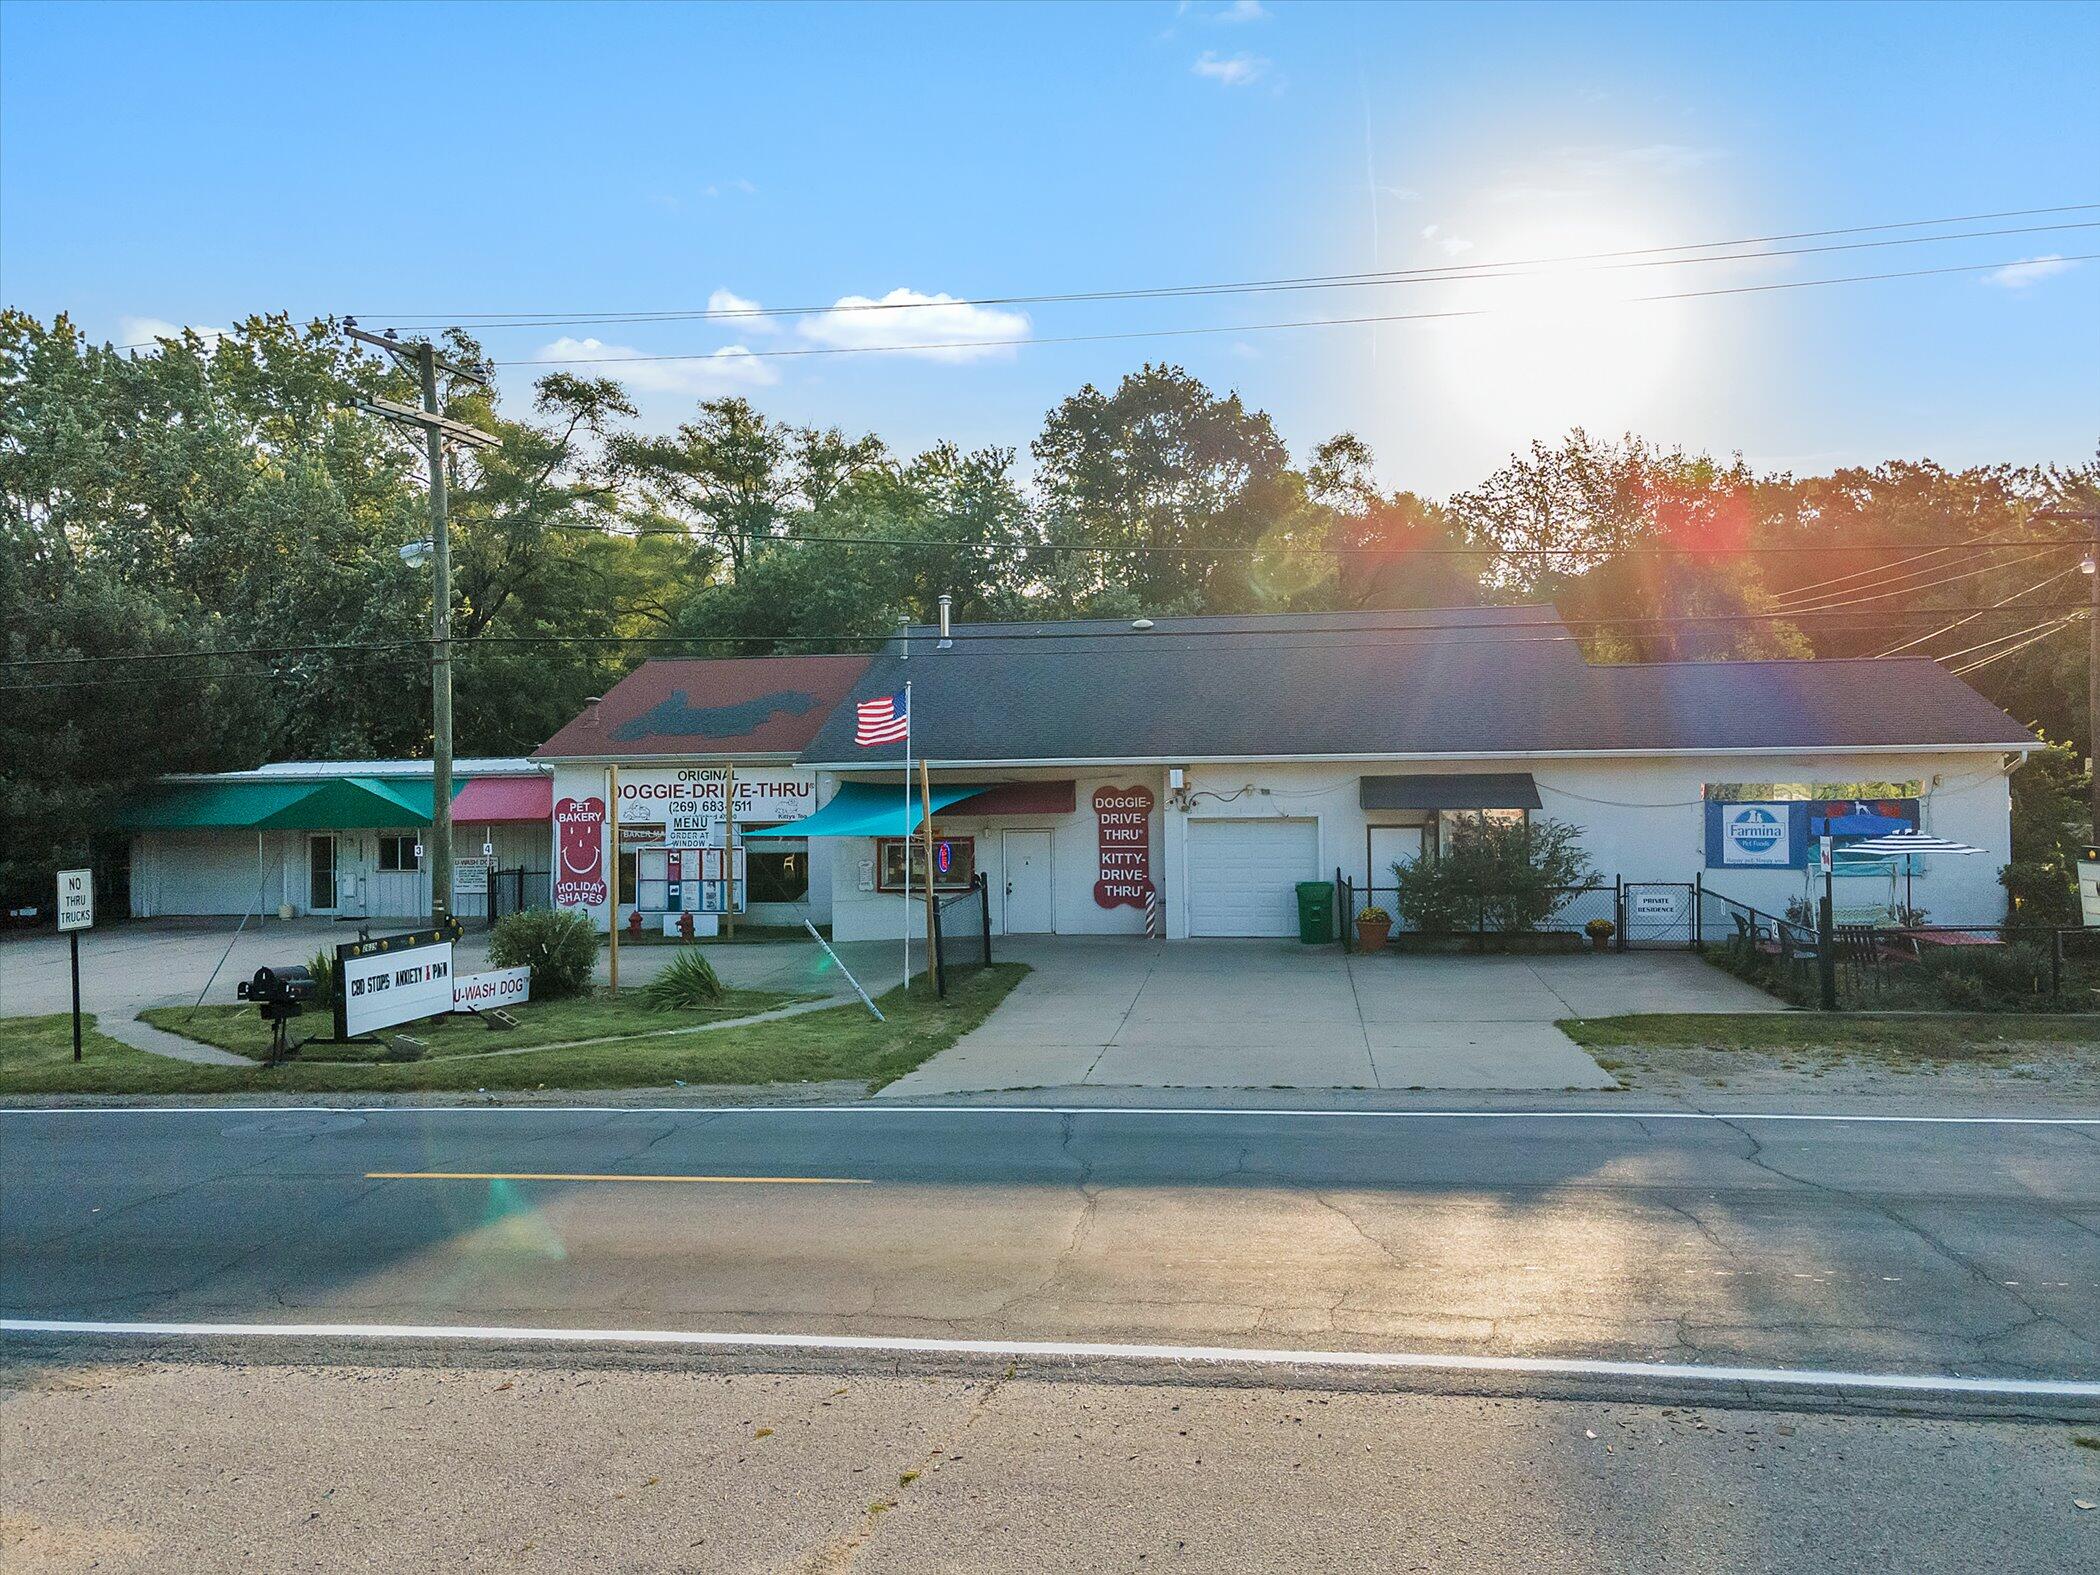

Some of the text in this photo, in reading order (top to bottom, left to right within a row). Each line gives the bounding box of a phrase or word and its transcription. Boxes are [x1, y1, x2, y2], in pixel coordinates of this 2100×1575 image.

[569, 802, 590, 811] PET
[669, 800, 752, 814] (269) 683-511
[1095, 797, 1151, 808] DOGGIE-
[559, 812, 601, 822] BAKERY
[674, 816, 708, 828] MENU
[1101, 813, 1146, 824] DRIVE-
[670, 832, 698, 840] ORDER
[700, 832, 709, 840] AT
[1730, 824, 1781, 837] Farmina
[485, 844, 490, 854] 4
[672, 840, 706, 848] WINDOW
[416, 846, 422, 855] 3
[1101, 853, 1146, 864] KITTY-
[1101, 869, 1148, 881] DRIVE-
[69, 877, 81, 890] NO
[557, 882, 605, 893] HOLIDAY
[66, 894, 86, 907] THRU
[558, 892, 604, 904] SHAPES
[61, 909, 91, 924] TRUCKS
[351, 978, 365, 997] CBD
[367, 973, 390, 994] STOPS
[395, 966, 423, 988] ANXIETY
[454, 982, 497, 1003] U-WASH
